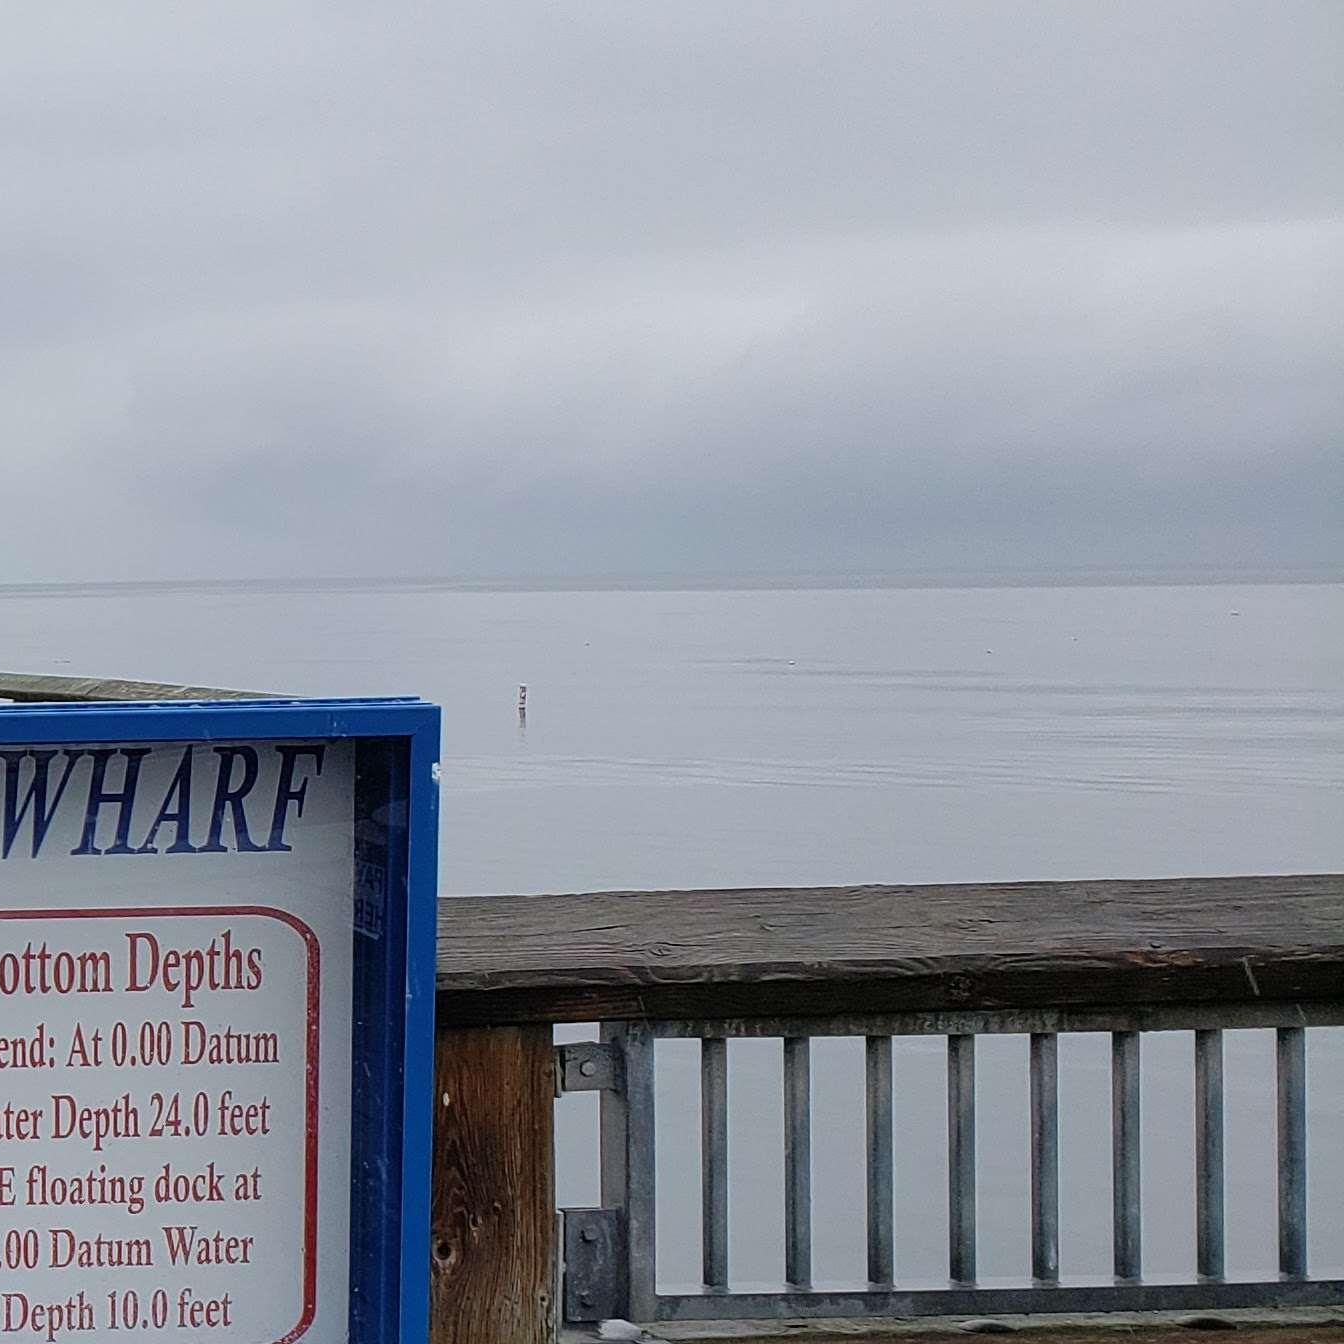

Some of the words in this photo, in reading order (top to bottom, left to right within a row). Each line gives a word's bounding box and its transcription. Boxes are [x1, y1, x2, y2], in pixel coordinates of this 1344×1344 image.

[125, 929, 262, 1008] Depths
[65, 1022, 103, 1067] At
[112, 1021, 171, 1066] 0.00
[180, 1021, 279, 1065] Datum
[51, 1093, 141, 1151] Depth
[149, 1092, 209, 1137] 24.0
[217, 1090, 270, 1135] feet
[26, 1164, 144, 1214] floating
[155, 1163, 225, 1203] dock
[235, 1166, 262, 1201] at
[48, 1229, 154, 1268] Datum
[162, 1226, 253, 1266] Water
[1, 1291, 96, 1342] Depth
[106, 1289, 167, 1330] 10.0
[177, 1289, 232, 1328] feet
